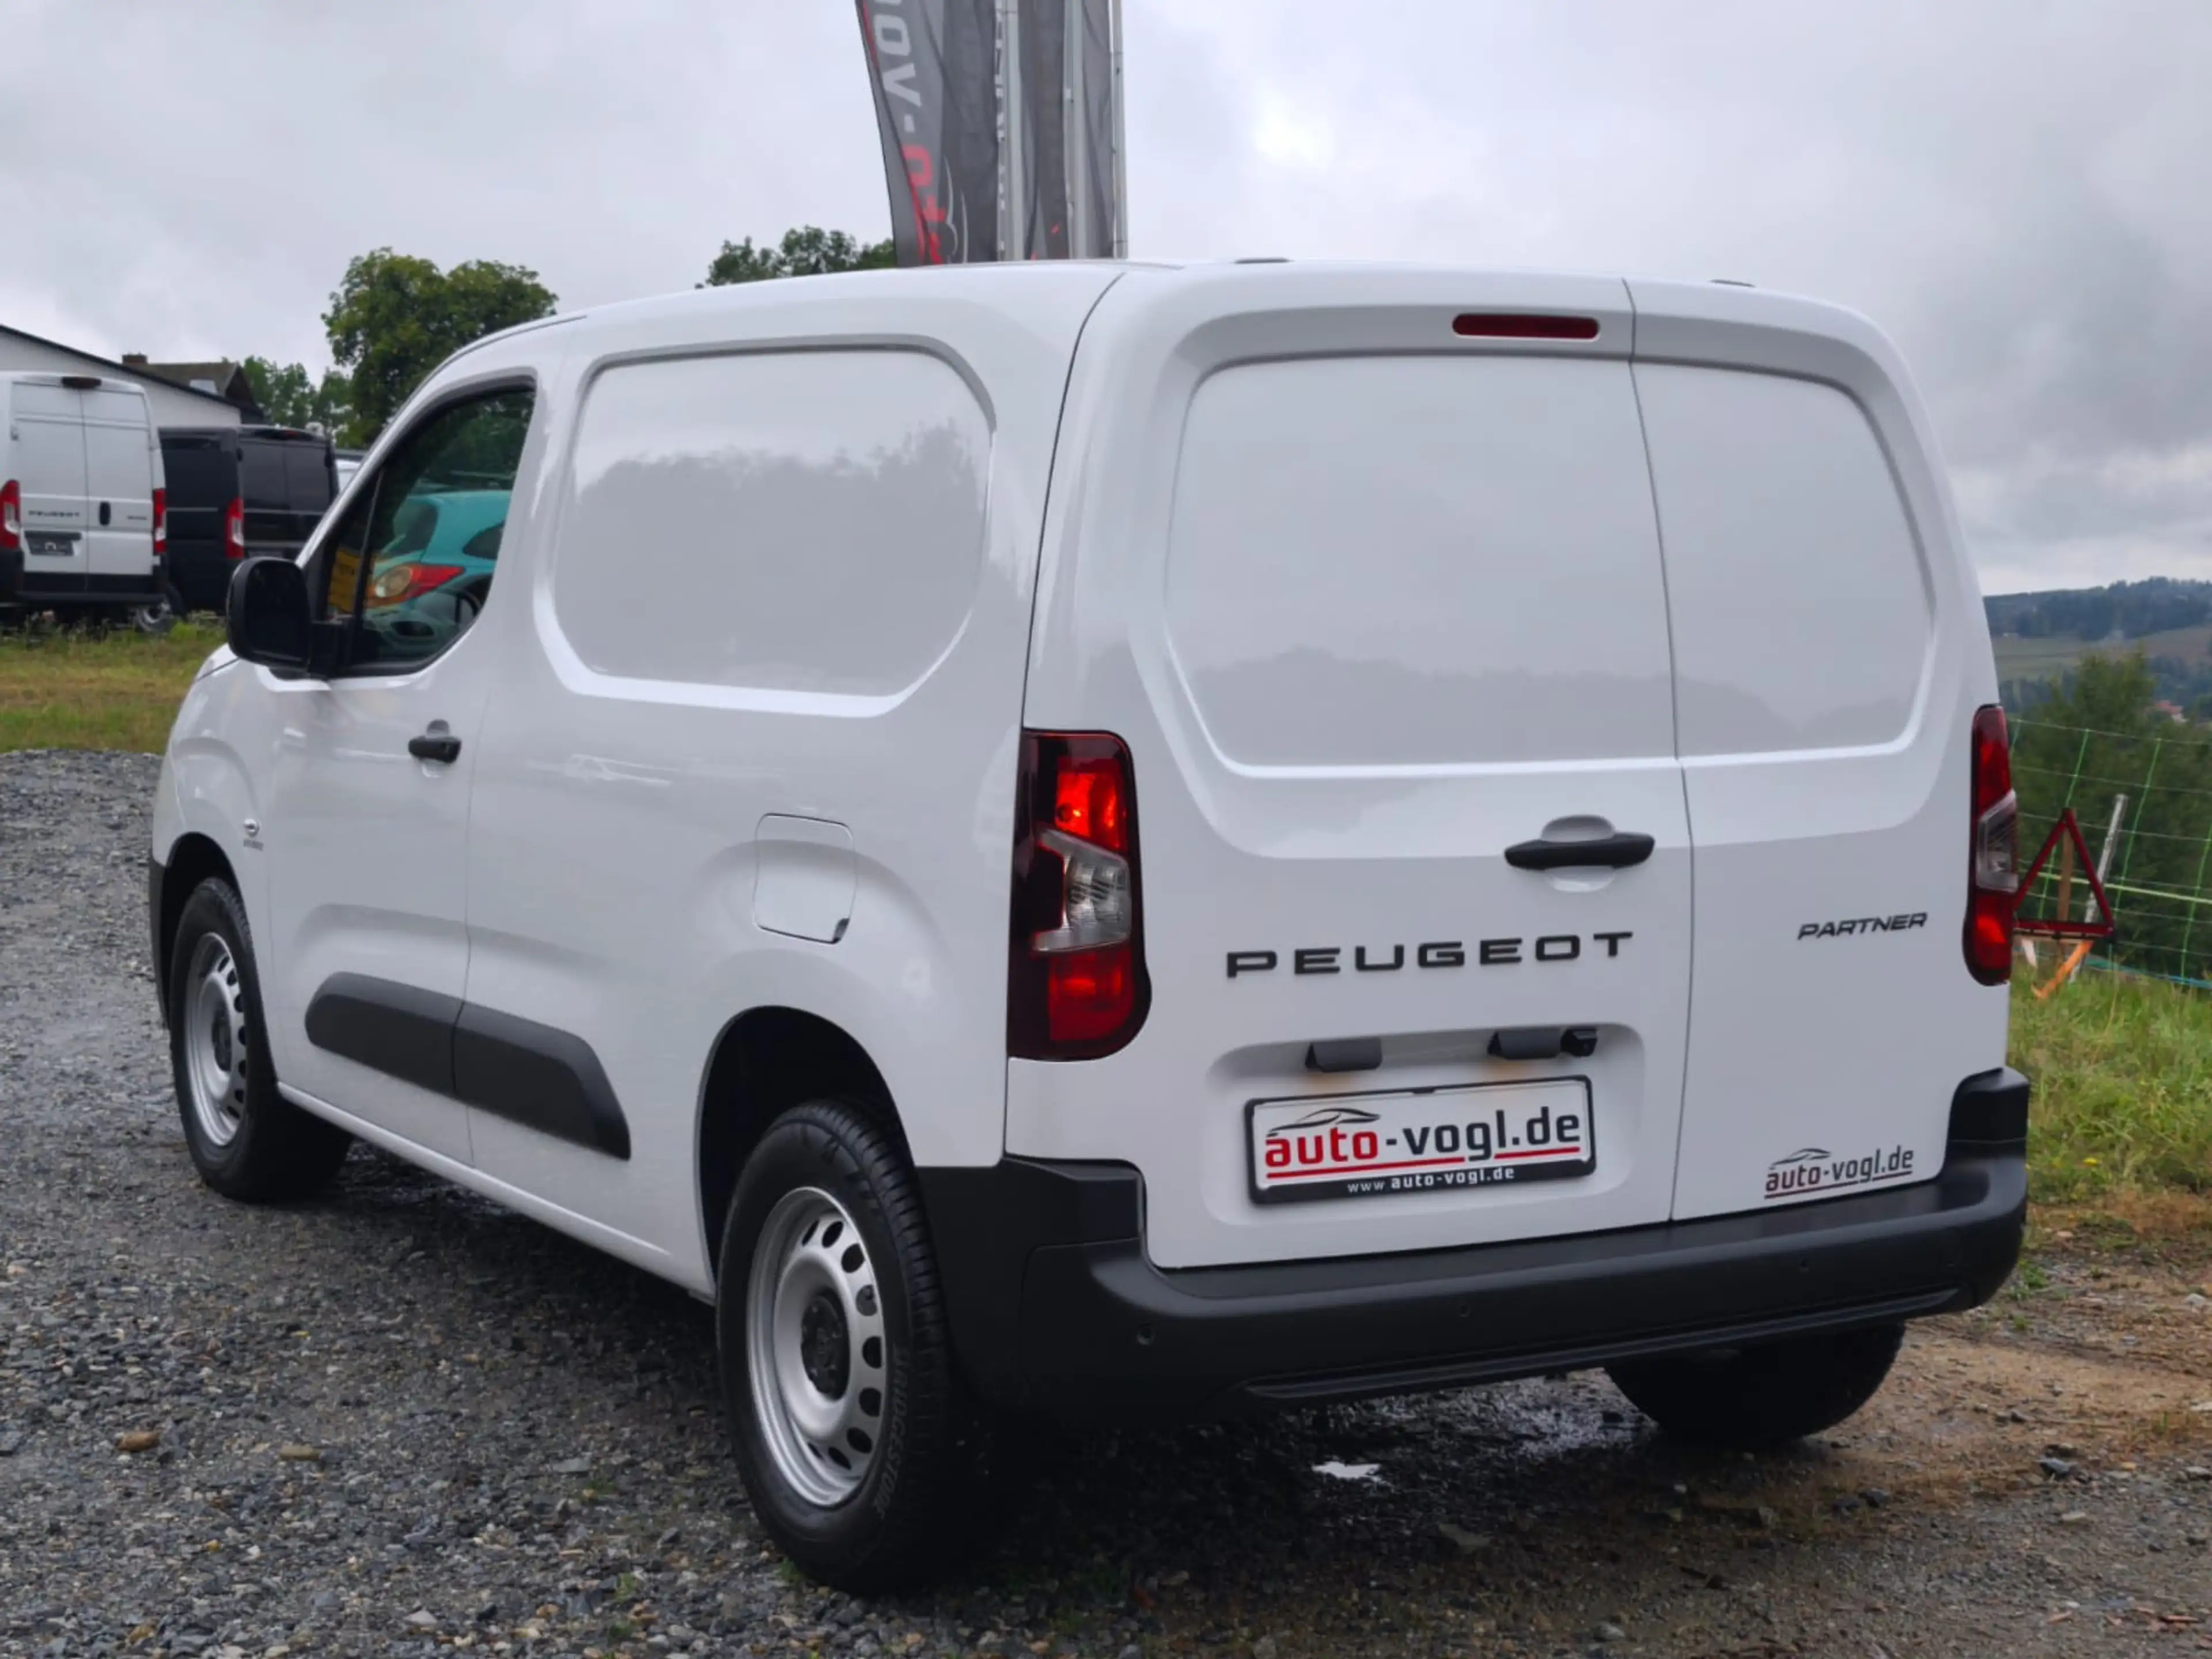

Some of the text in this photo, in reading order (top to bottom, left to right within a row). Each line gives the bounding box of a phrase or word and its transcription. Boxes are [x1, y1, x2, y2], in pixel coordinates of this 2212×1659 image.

[1798, 912, 1927, 940] PARTNER
[1227, 932, 1633, 978] PEUGEOT
[1265, 1107, 1580, 1167] auto-vogl.de
[1391, 1167, 1515, 1189] auto-vogl.de
[1765, 1145, 1914, 1191] auto-vogl.de
